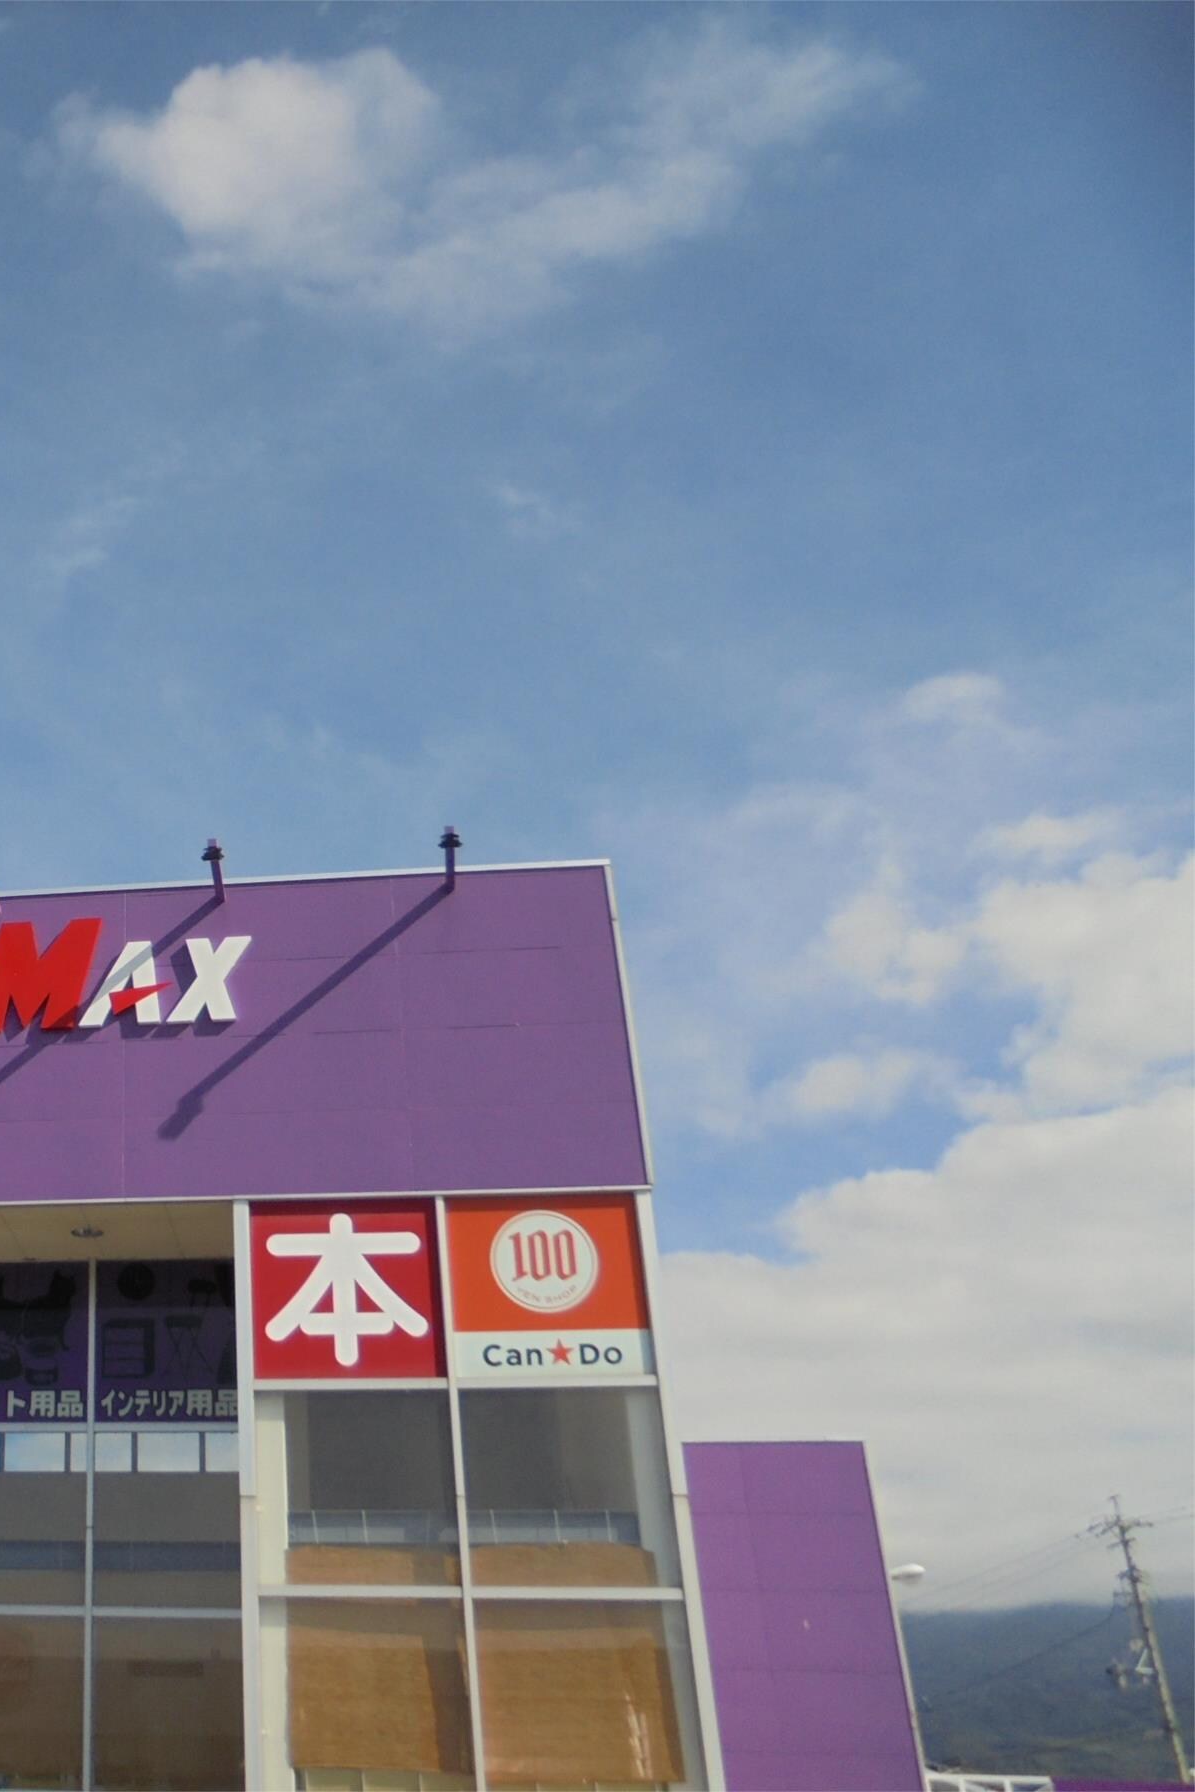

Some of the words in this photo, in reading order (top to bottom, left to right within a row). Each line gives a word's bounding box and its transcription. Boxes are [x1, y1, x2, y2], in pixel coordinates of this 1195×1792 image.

[508, 1229, 578, 1282] 100
[265, 1213, 429, 1367] 本
[100, 1388, 239, 1417] インテリア用品
